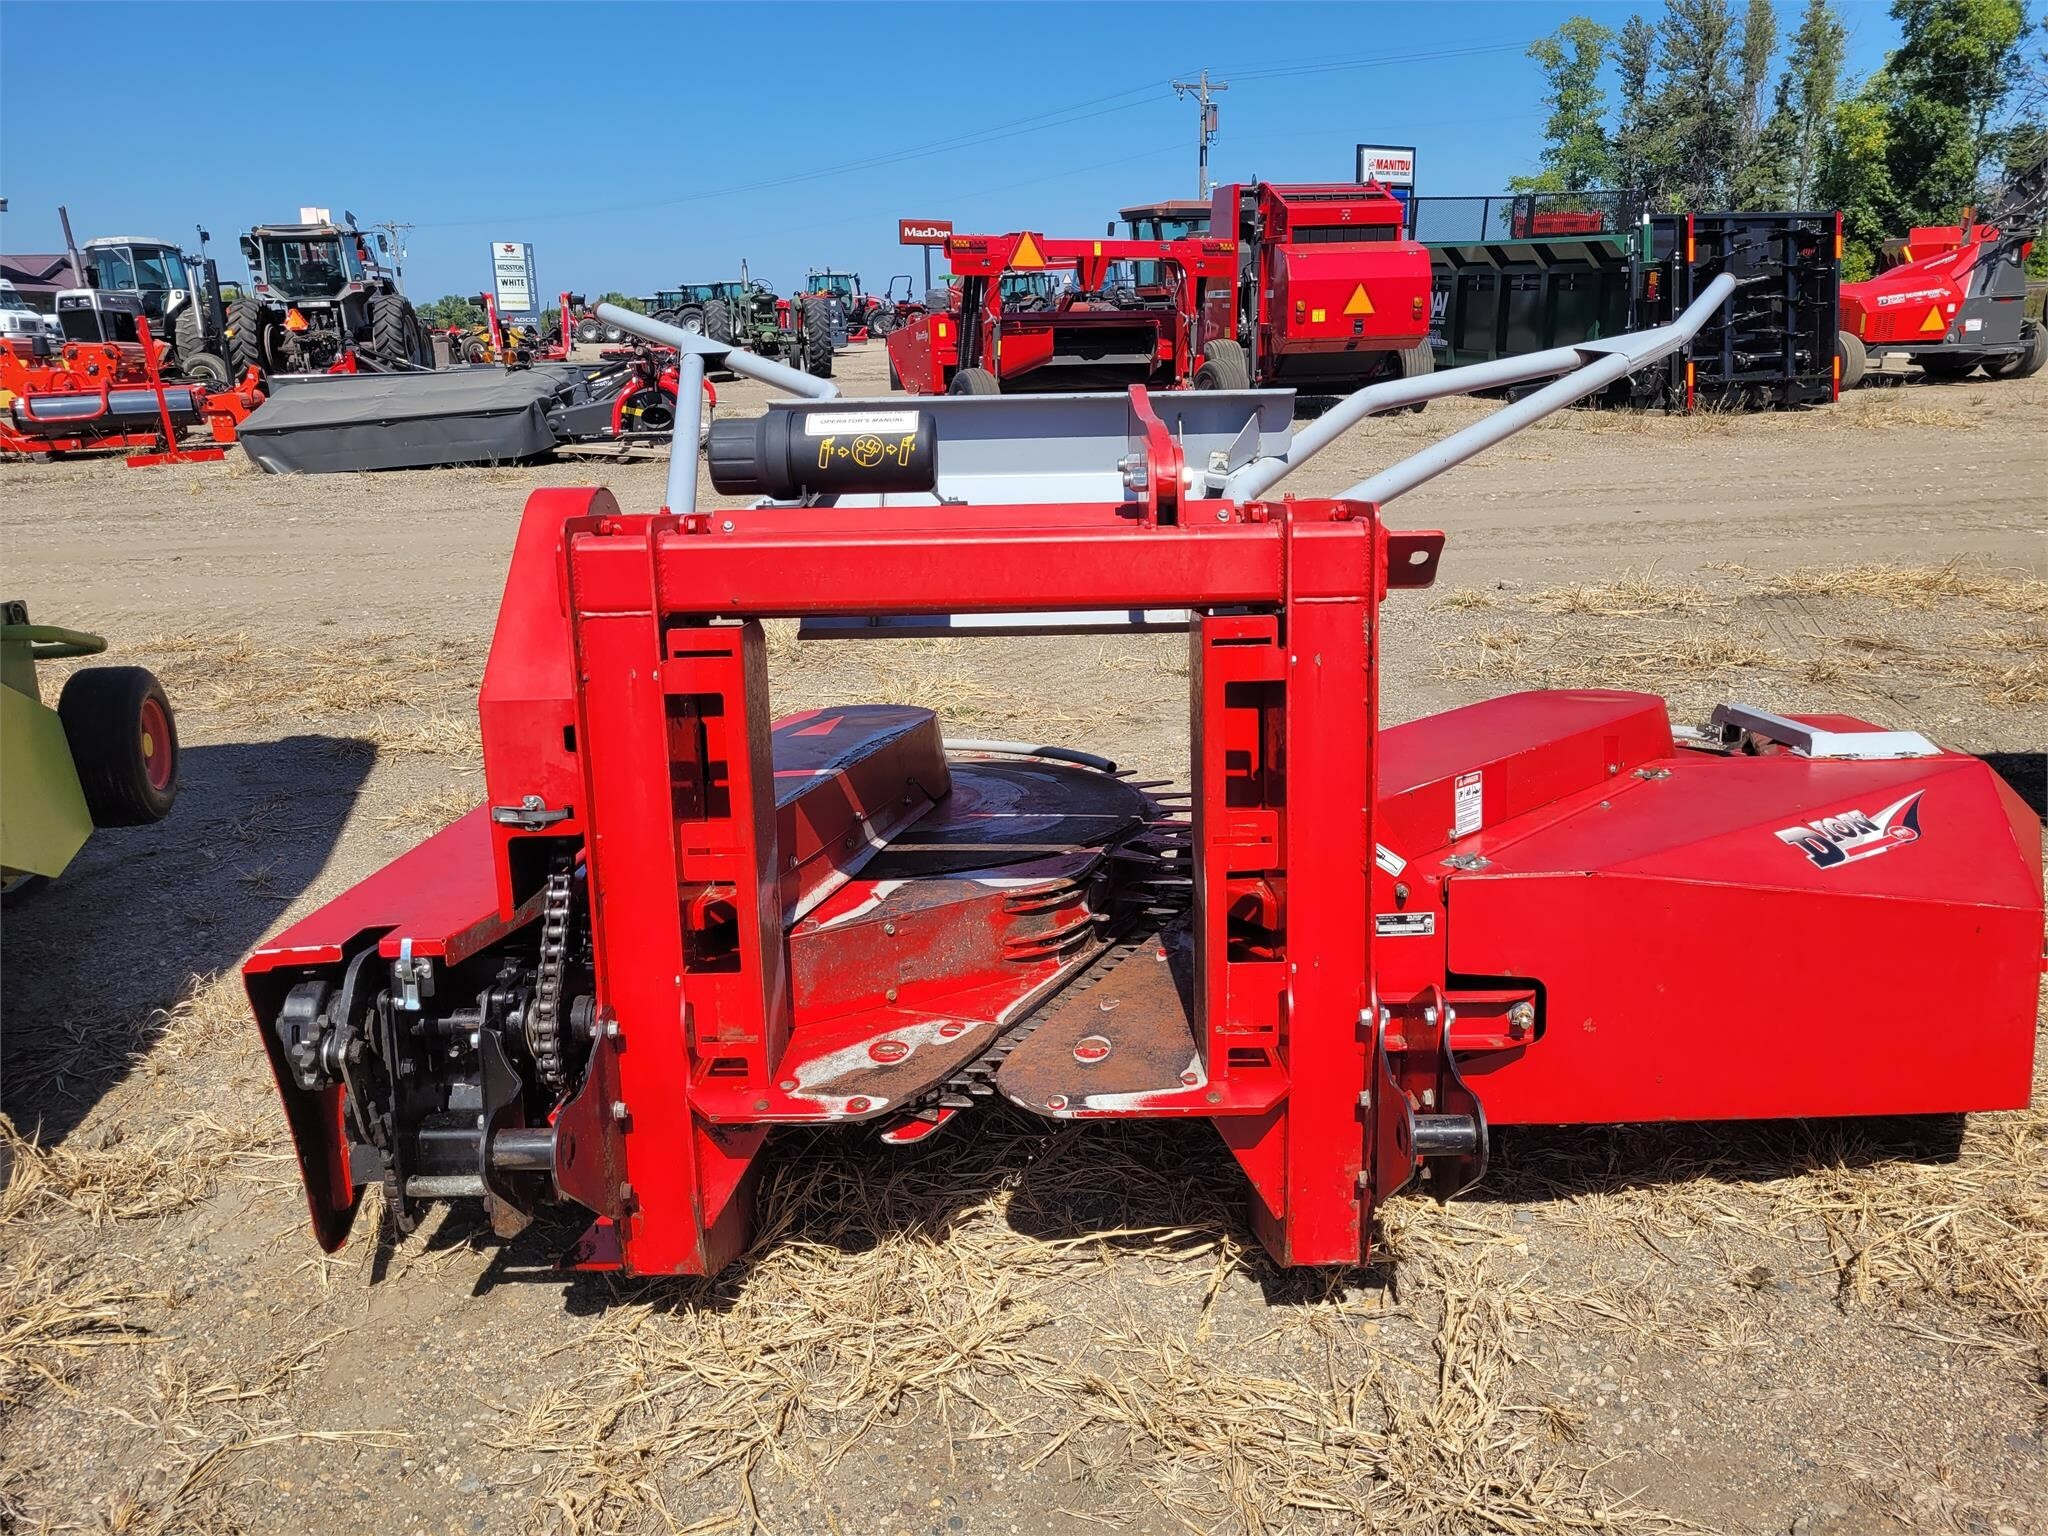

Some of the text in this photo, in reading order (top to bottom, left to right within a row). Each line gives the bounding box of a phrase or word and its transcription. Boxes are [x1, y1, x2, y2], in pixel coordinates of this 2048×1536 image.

[1376, 159, 1411, 170] MANITOU
[820, 417, 870, 425] OPERATOR'S
[1775, 810, 1880, 869] DION
